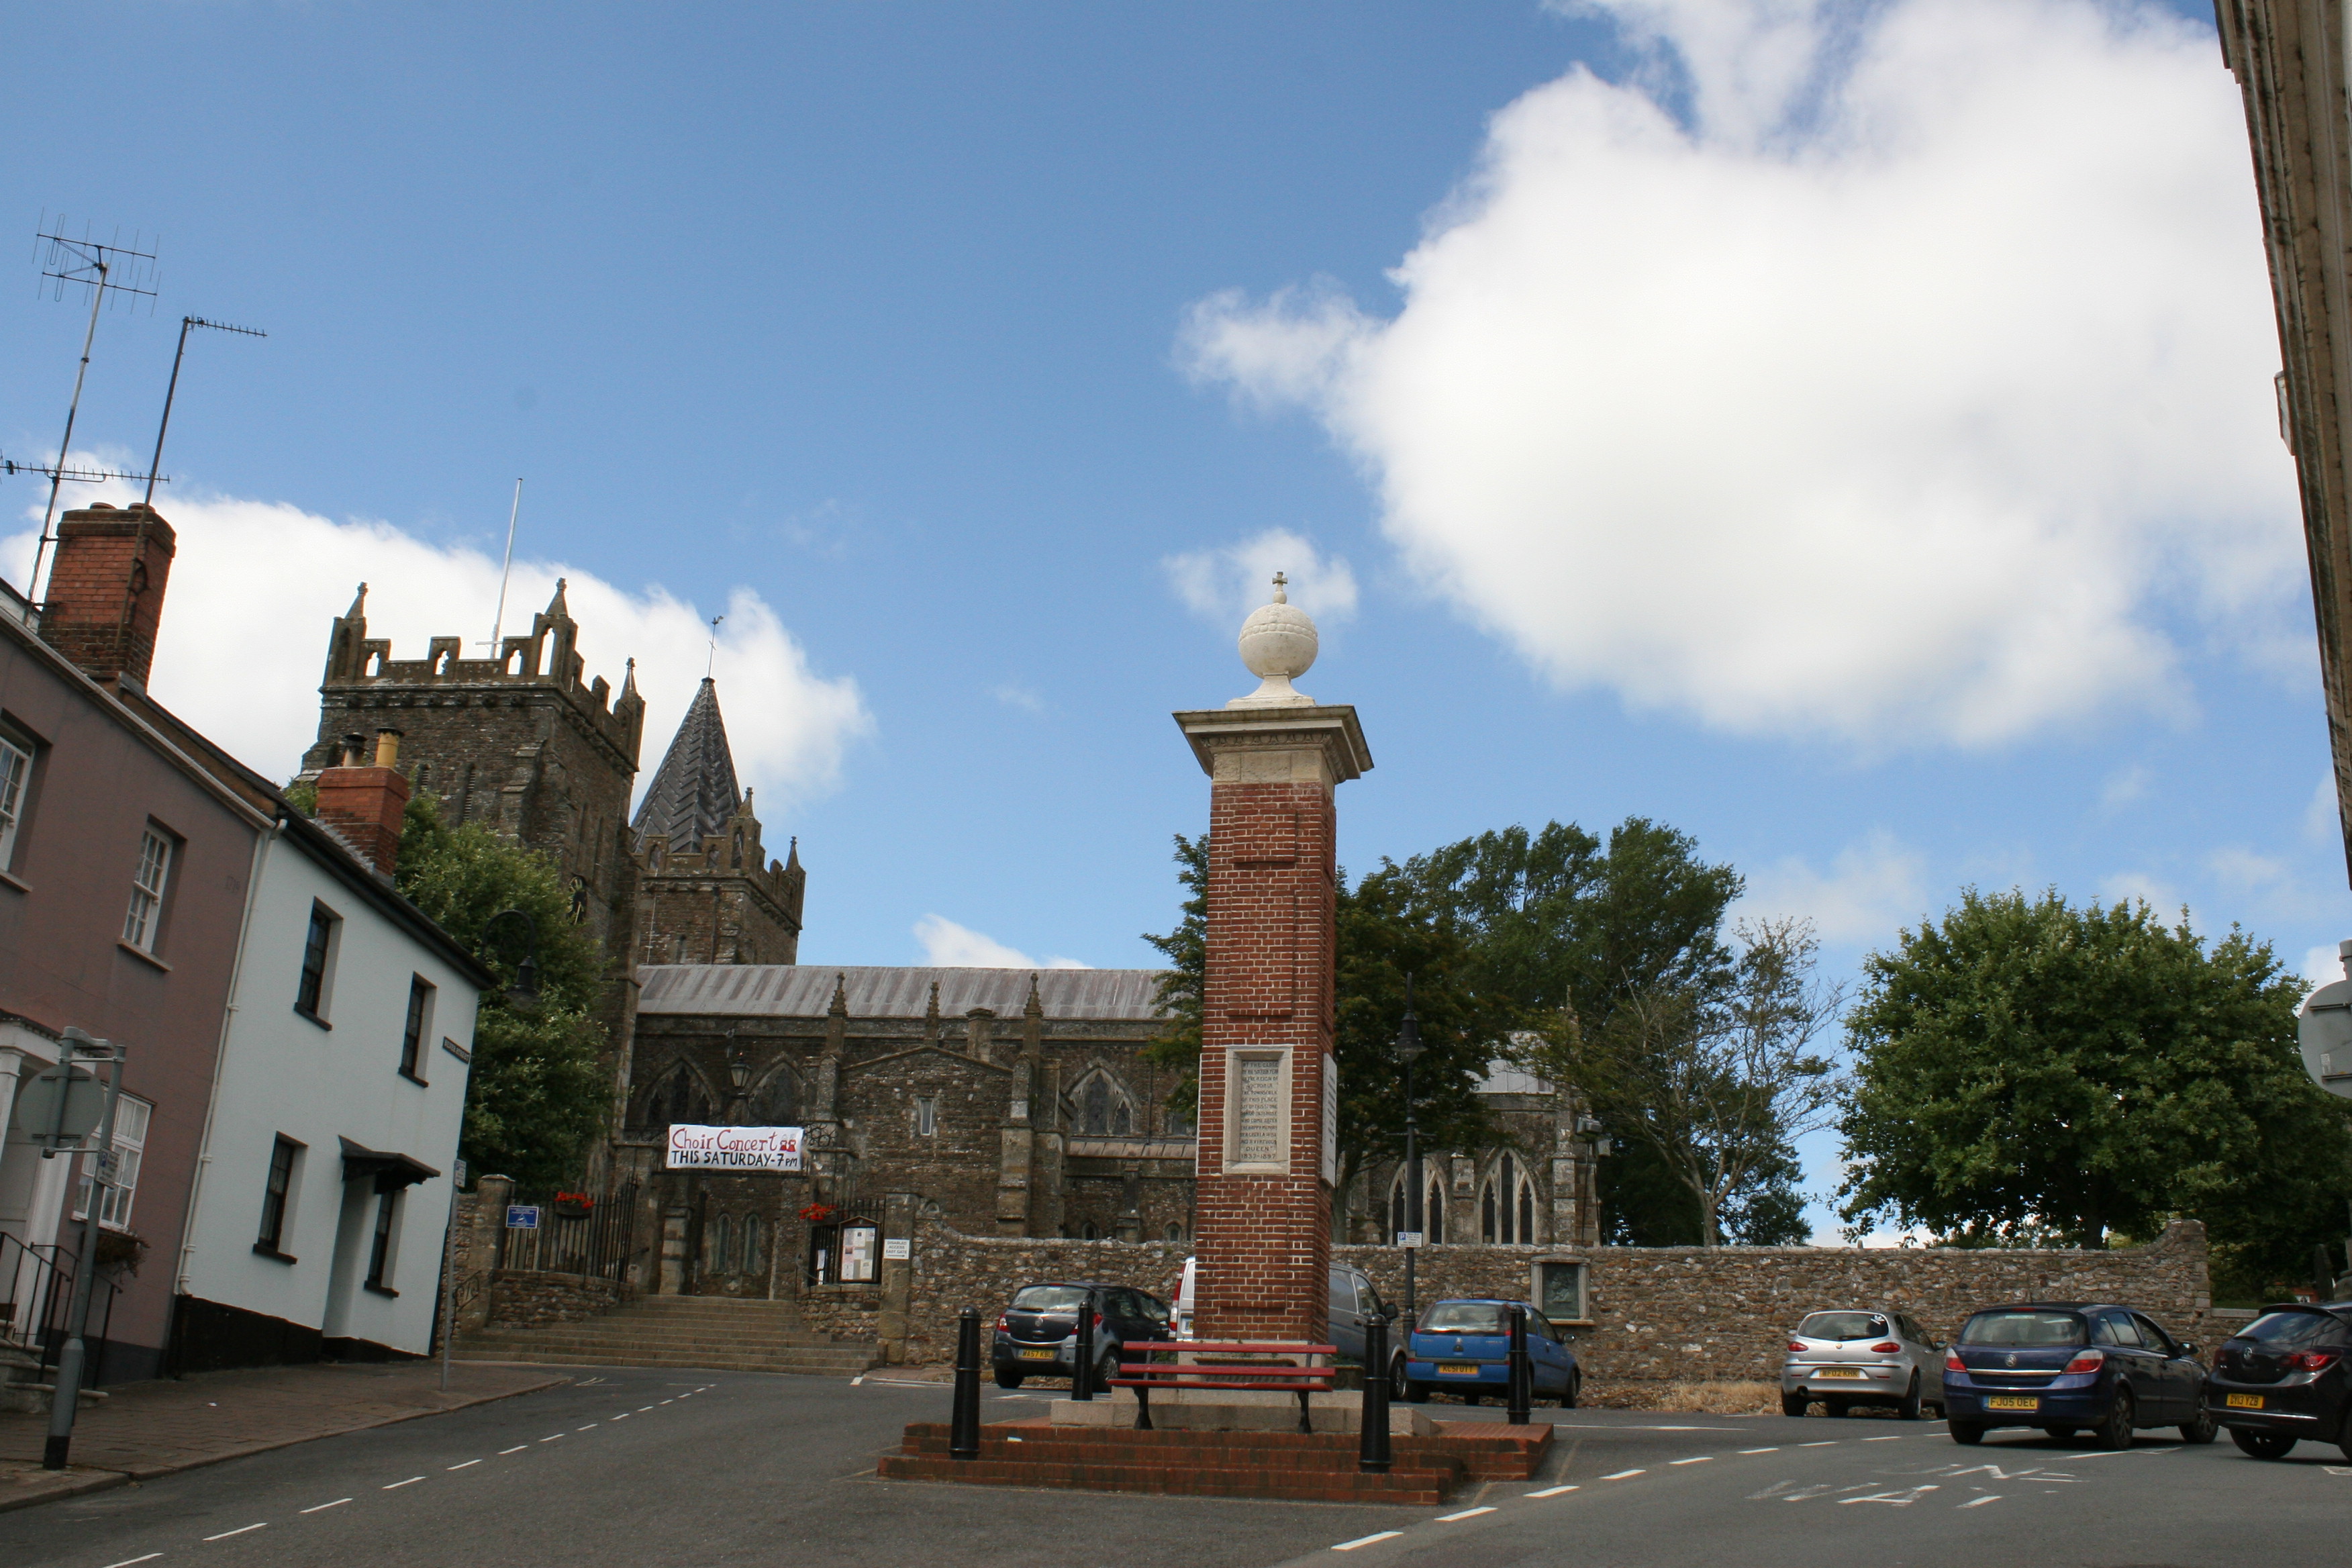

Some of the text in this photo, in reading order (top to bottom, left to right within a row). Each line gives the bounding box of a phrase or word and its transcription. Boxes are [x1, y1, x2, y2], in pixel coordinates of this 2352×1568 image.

[672, 1128, 778, 1152] Choir Concert
[671, 1150, 699, 1164] THIS
[1990, 1397, 2014, 1406] FJ05
